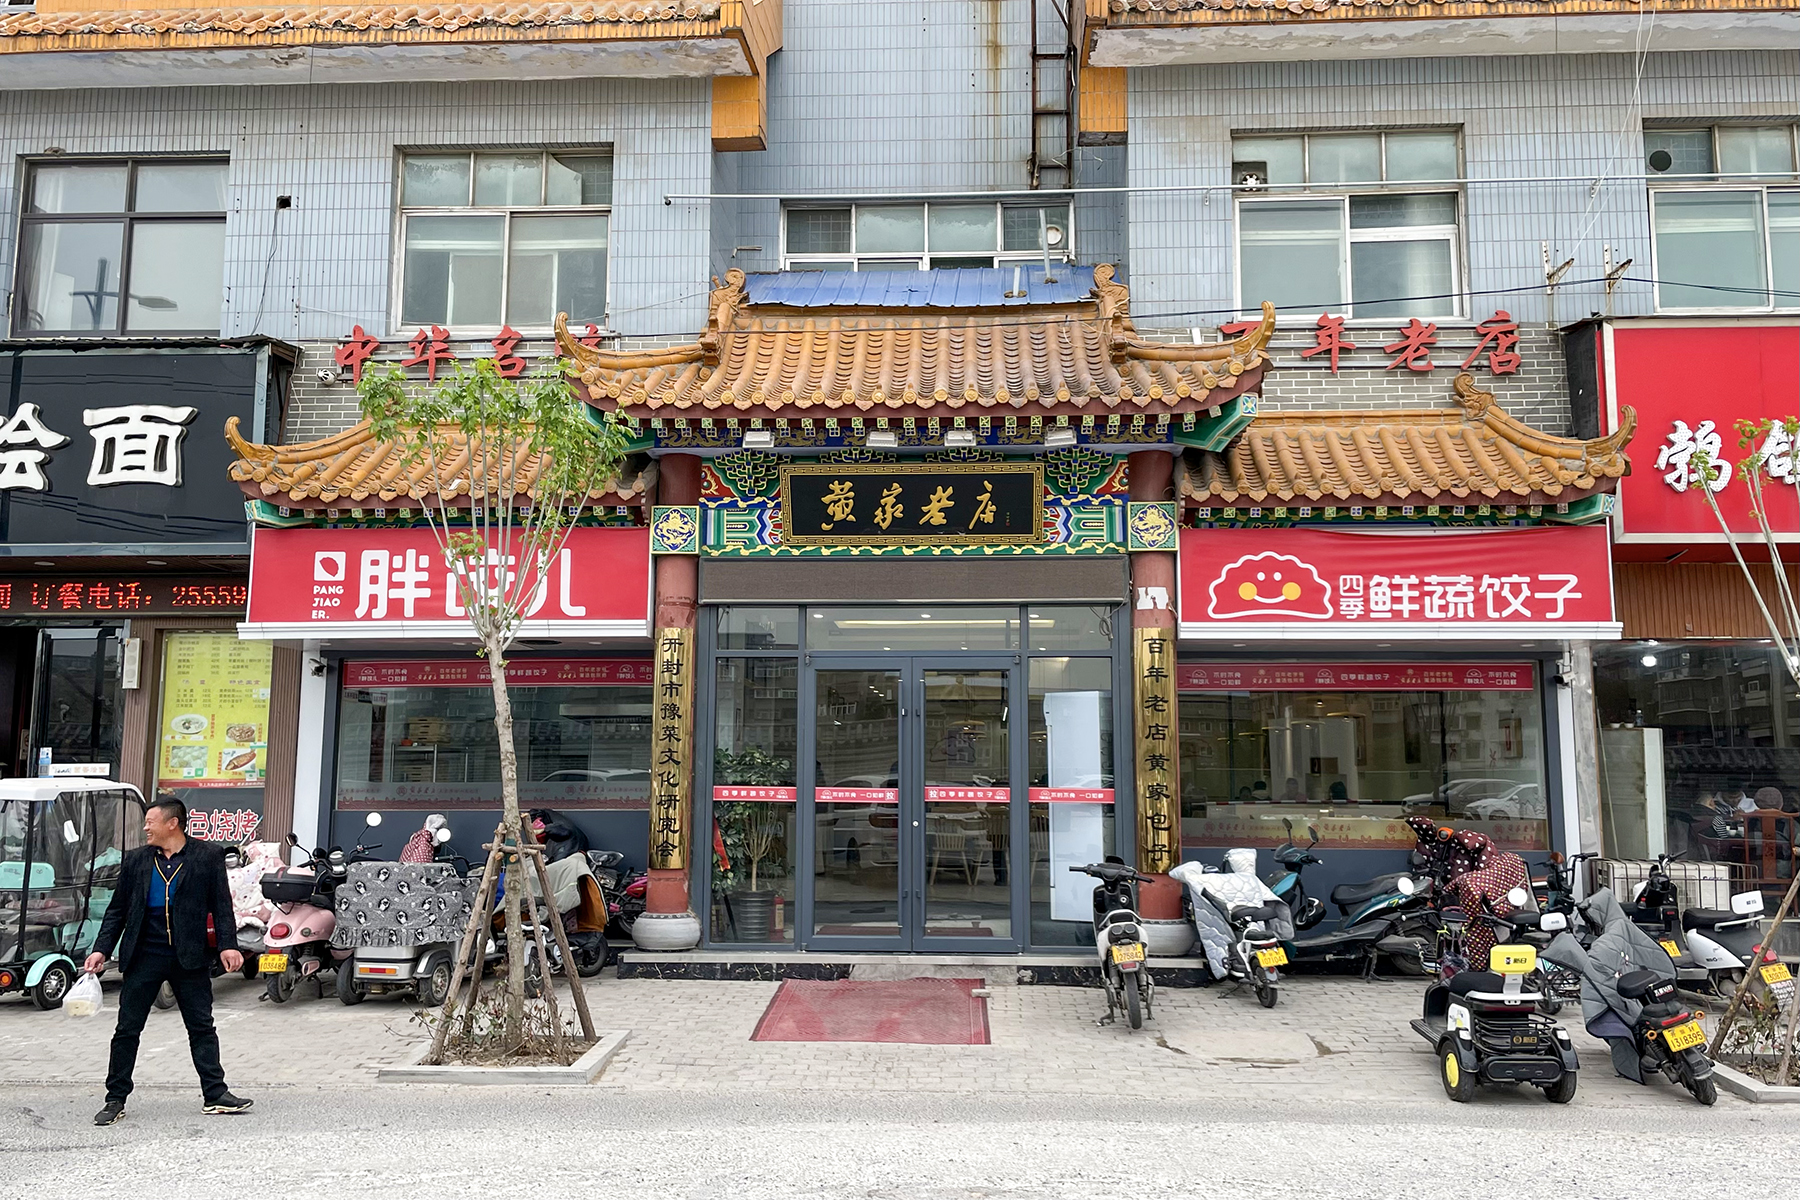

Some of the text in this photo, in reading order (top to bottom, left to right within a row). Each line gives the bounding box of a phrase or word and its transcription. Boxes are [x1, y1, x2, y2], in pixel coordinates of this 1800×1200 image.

[819, 479, 998, 531] 黄家老店
[312, 585, 344, 595] PANG
[312, 598, 341, 607] JIAO
[1339, 573, 1582, 619] 四季 鲜蔬饺子
[311, 610, 330, 619] ER.
[656, 637, 685, 858] 开封市豫菜文化研究会
[1143, 637, 1172, 864] 百年老店黄家包子
[186, 808, 260, 841] 色烧烤
[1670, 1030, 1704, 1049] 1318395
